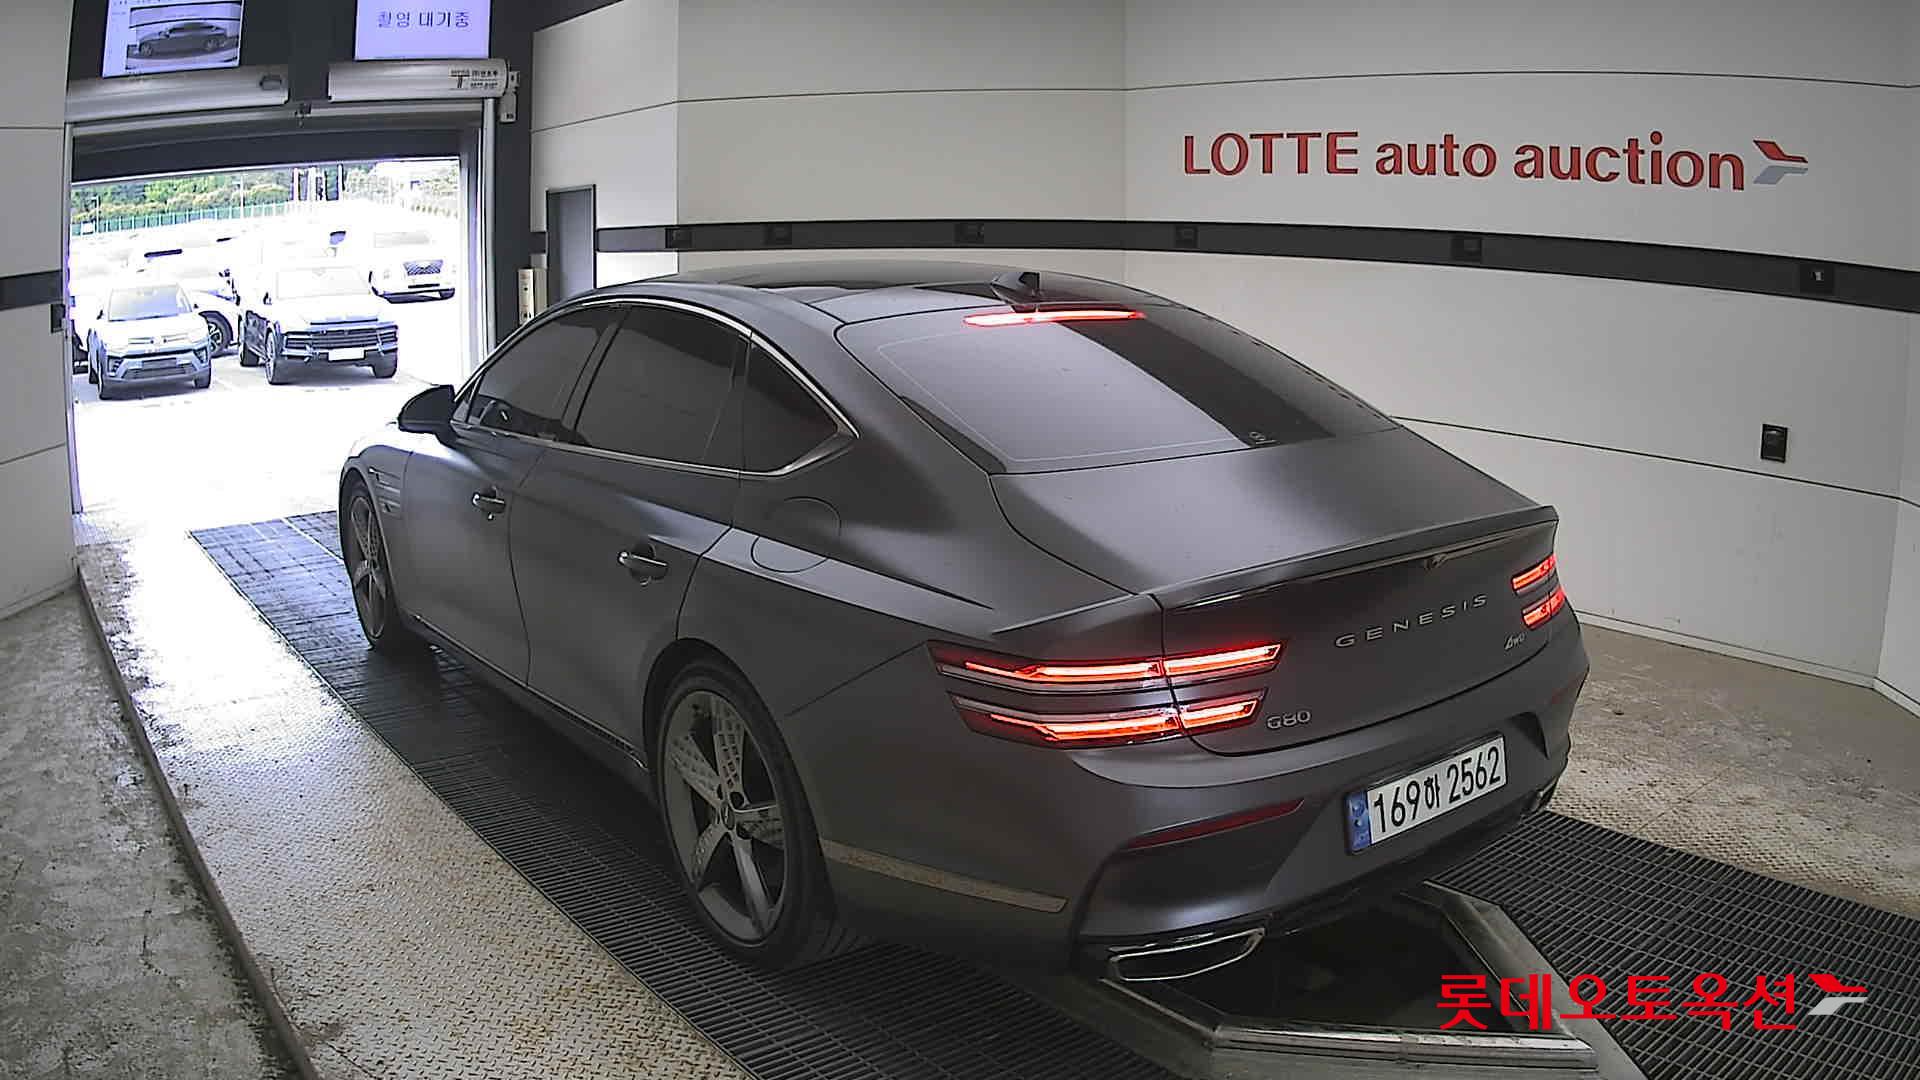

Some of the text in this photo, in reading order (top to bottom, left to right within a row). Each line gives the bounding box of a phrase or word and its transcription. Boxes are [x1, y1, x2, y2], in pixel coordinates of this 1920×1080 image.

[419, 11, 469, 28] 대기중
[1184, 130, 1746, 191] LOTTE auto auction
[1334, 593, 1488, 648] GENESIS
[1266, 710, 1312, 729] G80
[1373, 746, 1502, 834] 169하 2562
